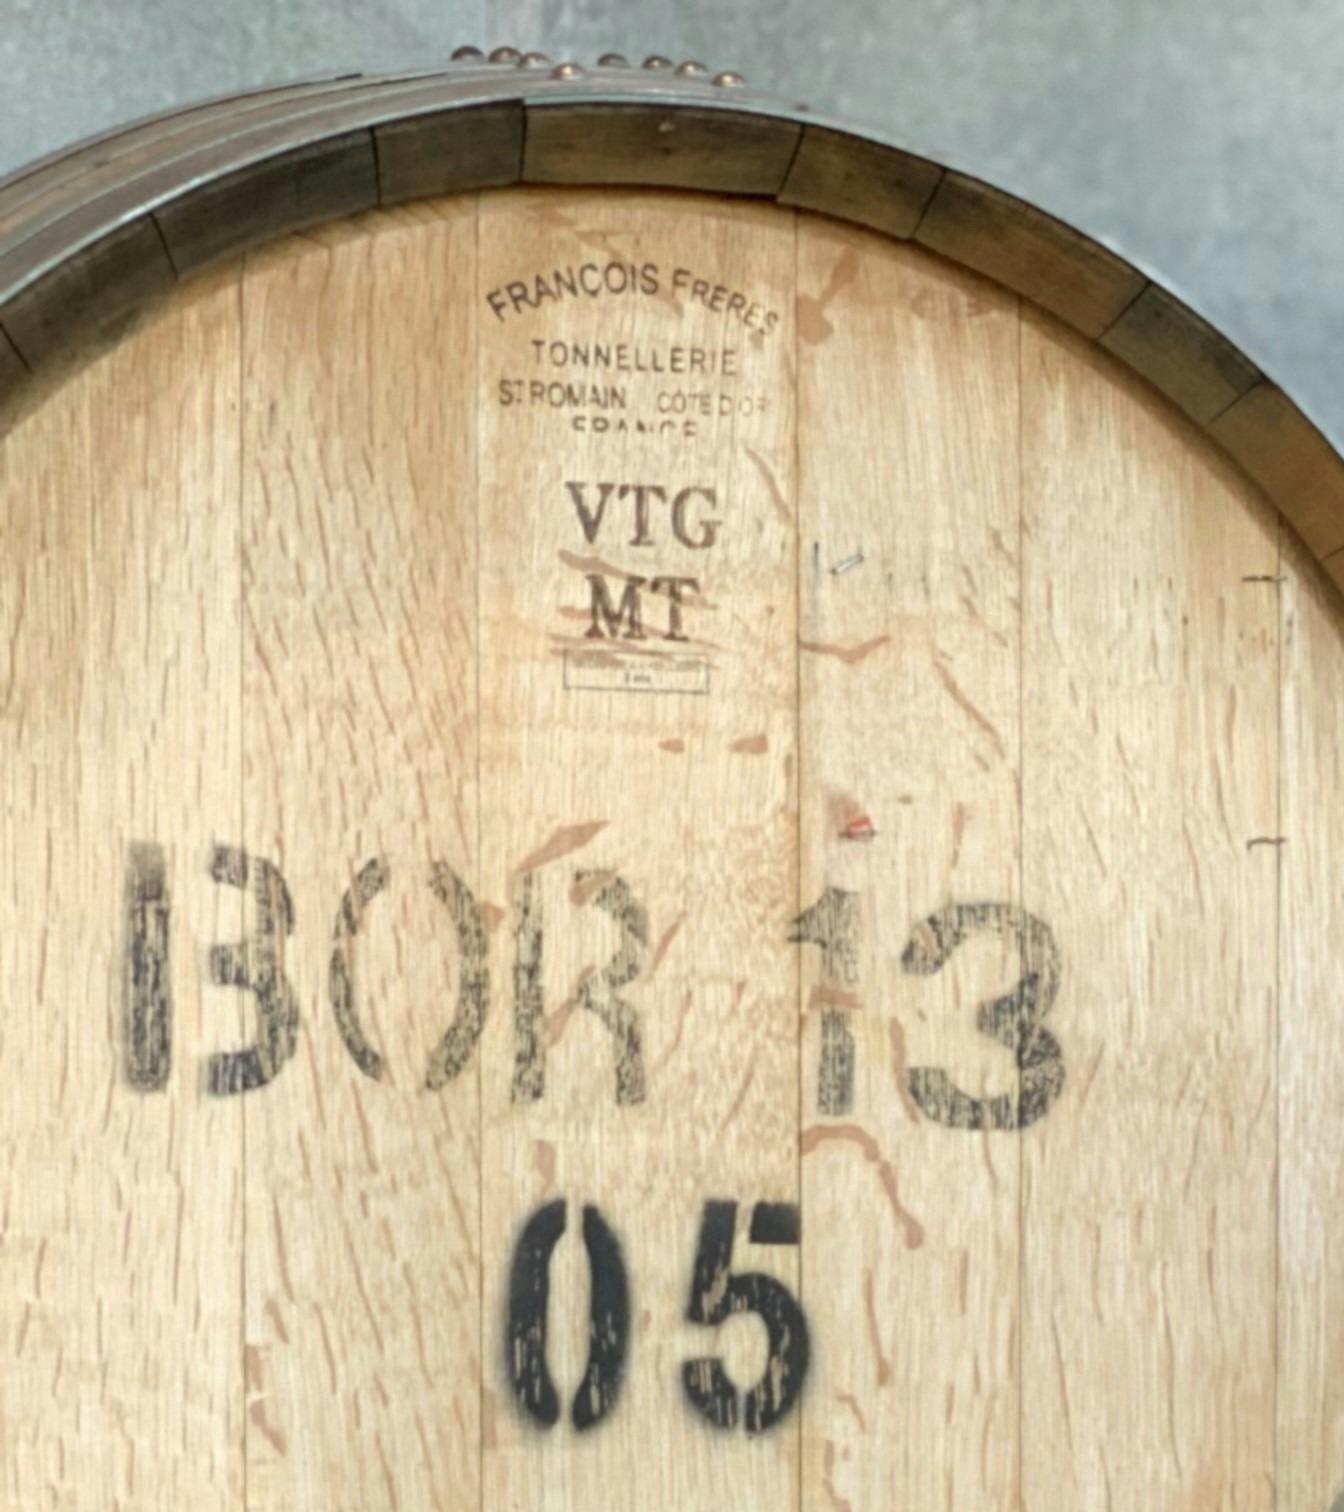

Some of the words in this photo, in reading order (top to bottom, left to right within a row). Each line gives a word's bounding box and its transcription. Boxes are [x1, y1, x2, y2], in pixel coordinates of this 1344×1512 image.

[531, 338, 738, 376] TONNELLERIE
[565, 481, 722, 549] VTG
[583, 573, 701, 642] MT
[117, 839, 649, 1107] BOR
[785, 886, 1068, 1133] 13
[504, 1198, 812, 1435] 05
